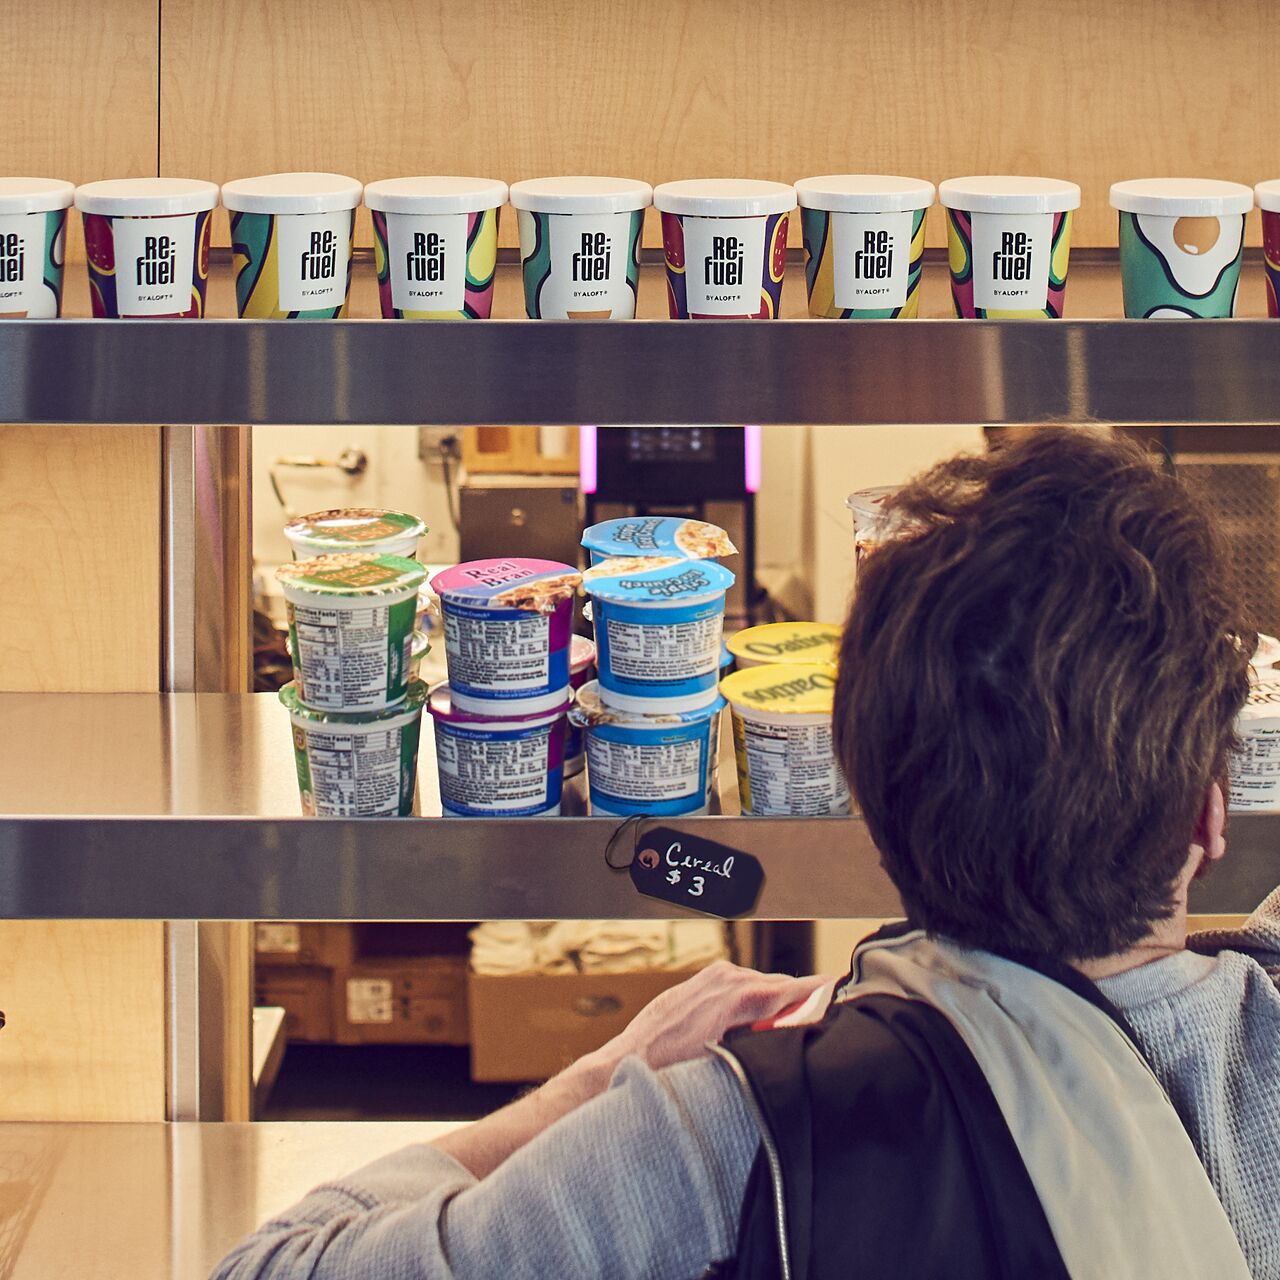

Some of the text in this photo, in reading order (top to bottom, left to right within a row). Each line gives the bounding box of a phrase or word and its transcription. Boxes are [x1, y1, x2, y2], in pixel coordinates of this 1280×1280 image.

[414, 232, 447, 254] Re:
[406, 251, 446, 282] fuel
[465, 561, 518, 580] Real
[481, 569, 534, 588] Bran
[666, 842, 735, 878] Cereal
